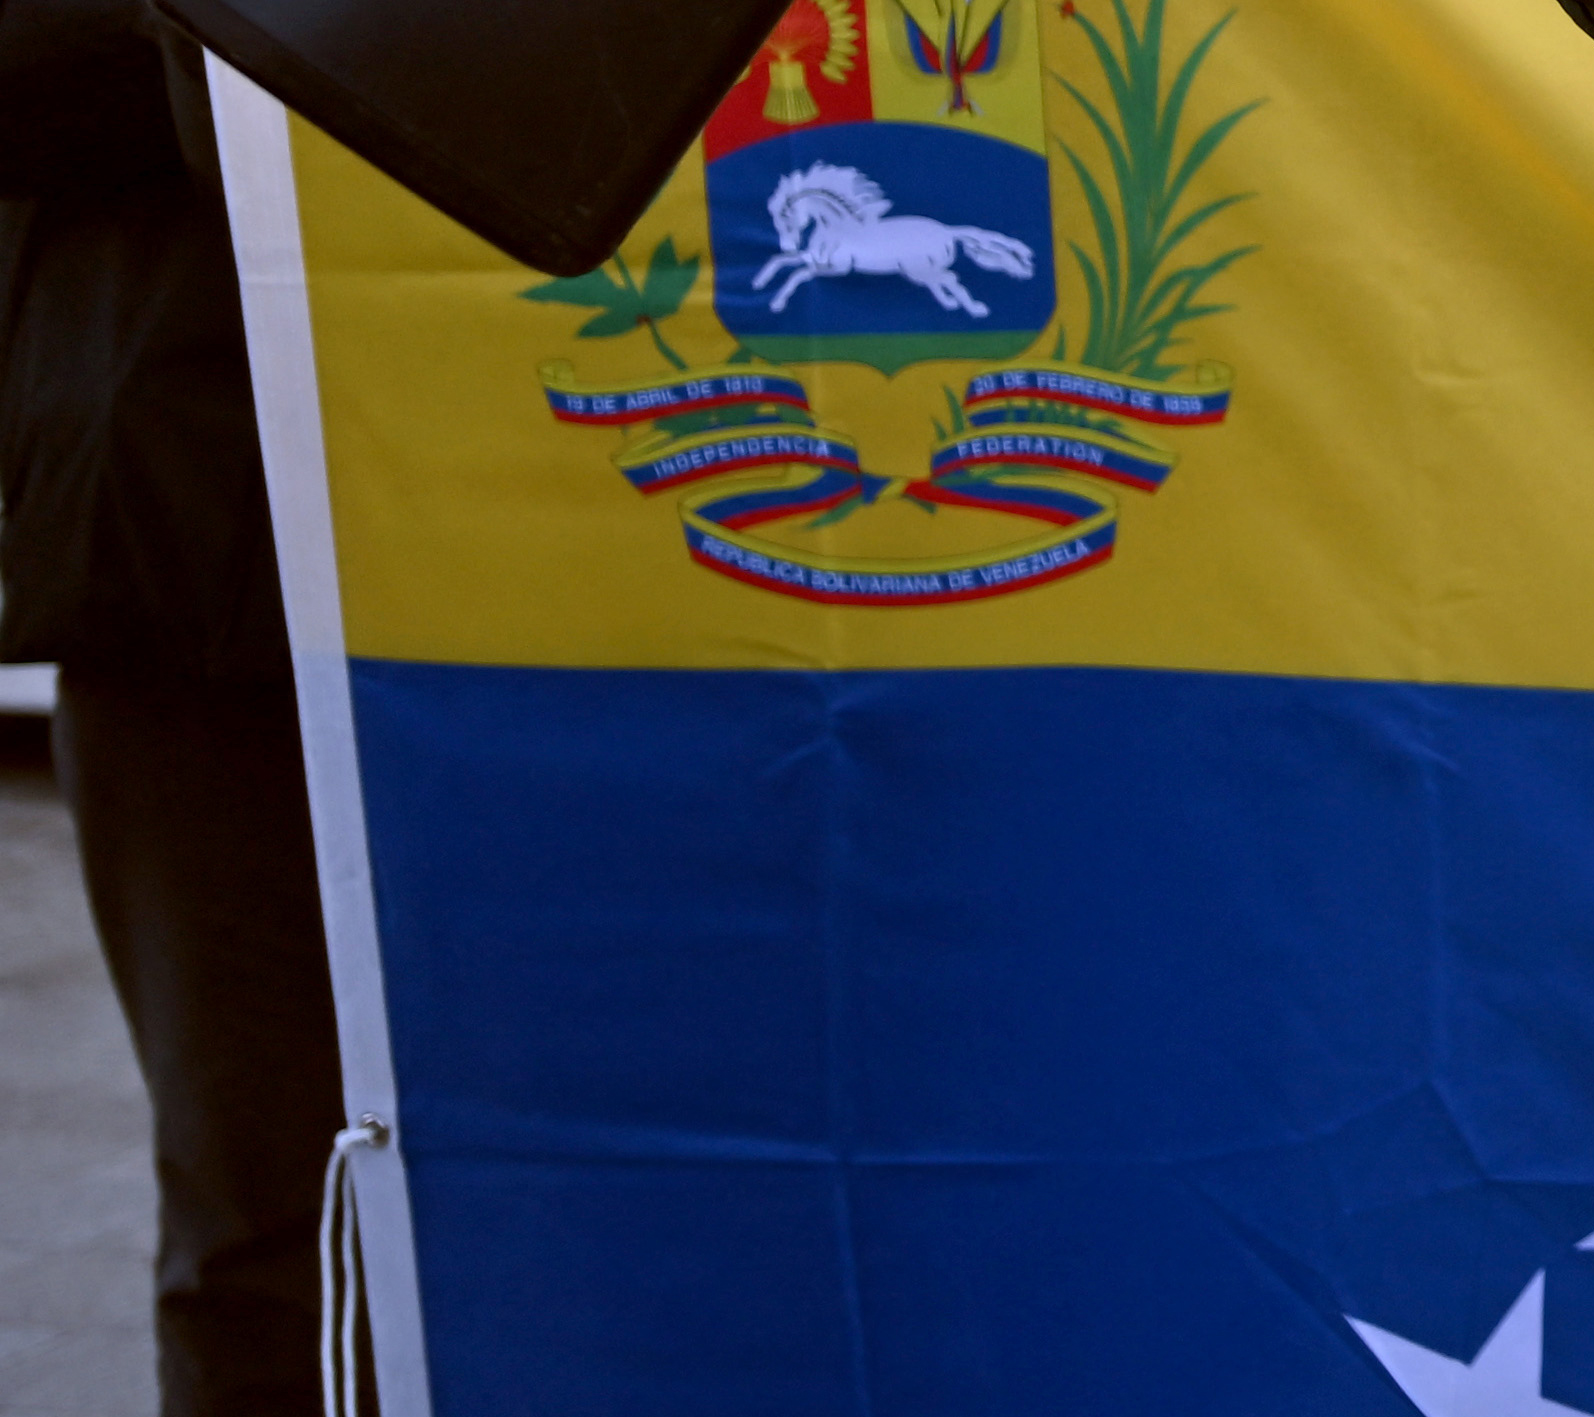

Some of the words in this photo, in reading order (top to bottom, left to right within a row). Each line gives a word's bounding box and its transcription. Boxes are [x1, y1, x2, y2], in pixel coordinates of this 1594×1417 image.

[592, 396, 617, 414] DE
[625, 388, 680, 411] ABRIL
[685, 380, 714, 399] DE
[1002, 371, 1026, 389] DE
[1036, 373, 1123, 405] FEBRERO
[1129, 388, 1155, 410] DE
[653, 435, 831, 478] INDEPENDENCIA
[811, 569, 941, 595] BOLIVARIANA
[948, 568, 976, 591] DE
[979, 537, 1091, 587] VENEZUELA
